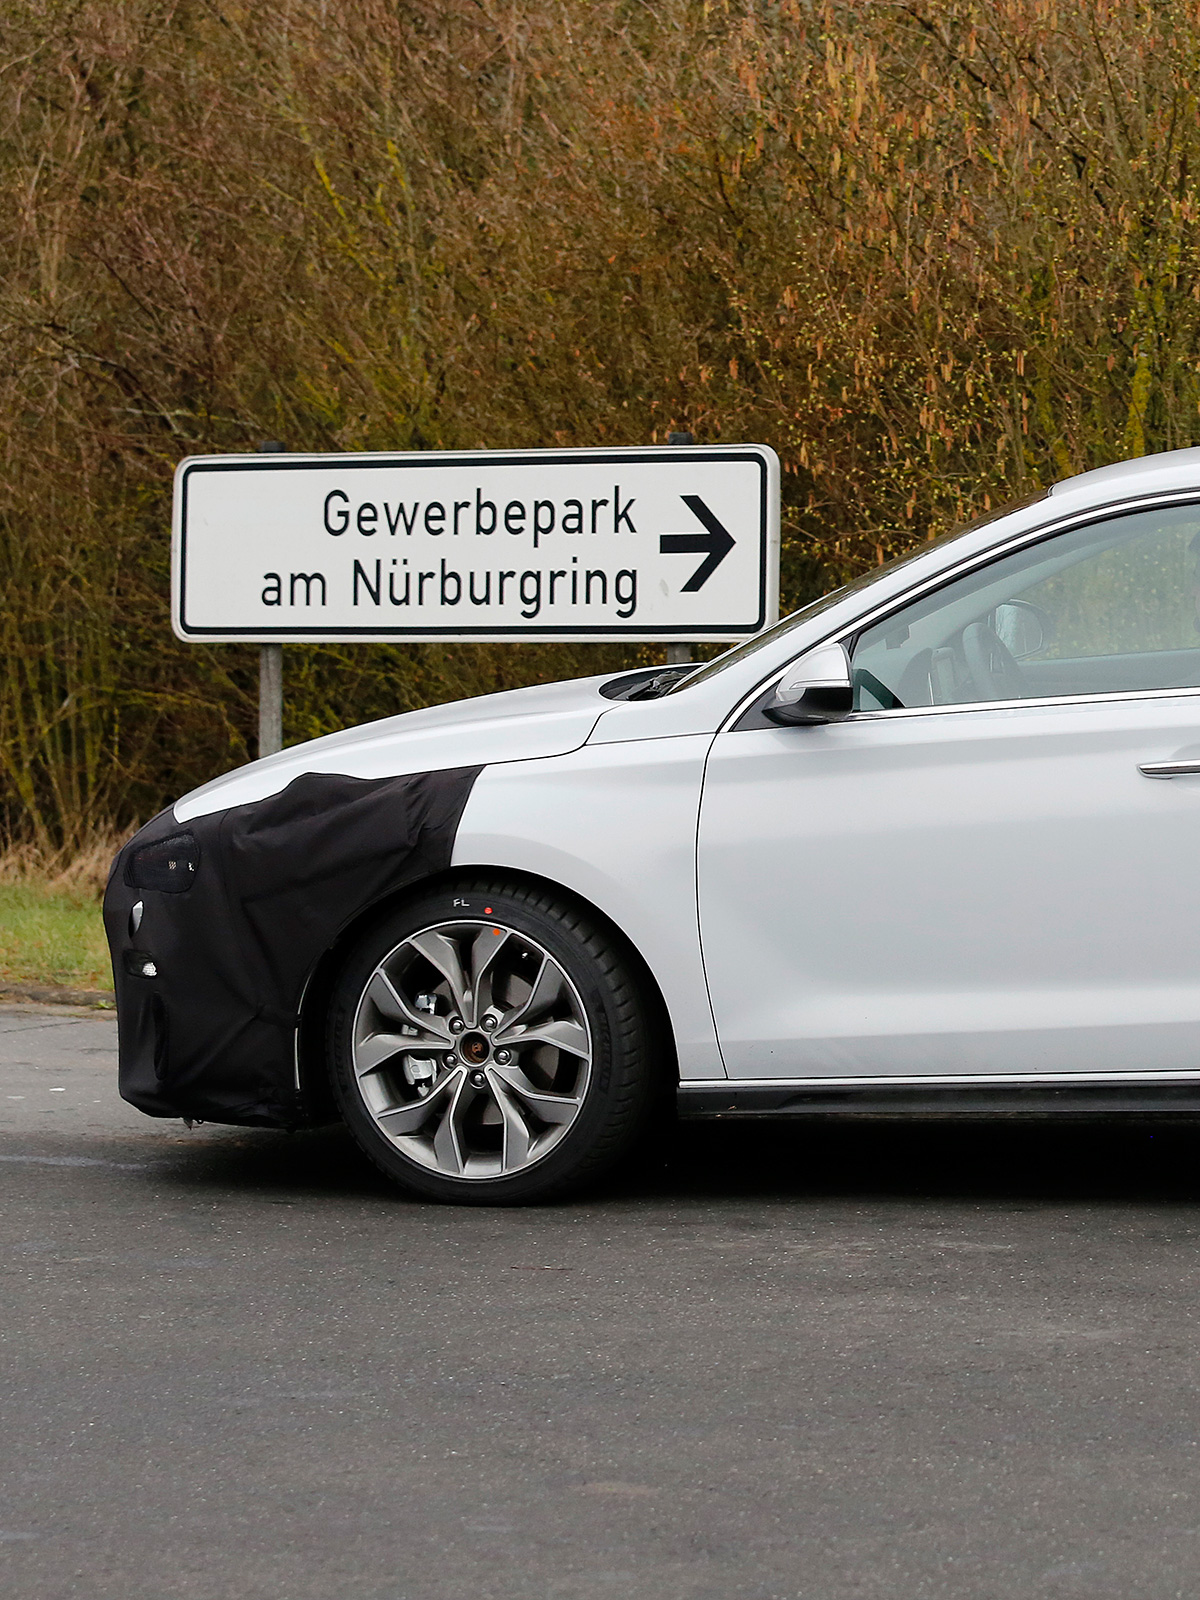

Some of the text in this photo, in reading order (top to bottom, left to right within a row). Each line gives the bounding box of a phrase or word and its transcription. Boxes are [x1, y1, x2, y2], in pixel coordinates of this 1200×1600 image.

[323, 485, 637, 548] Gewerbepark
[261, 556, 637, 619] am Nürburgring
[453, 898, 470, 907] FL
